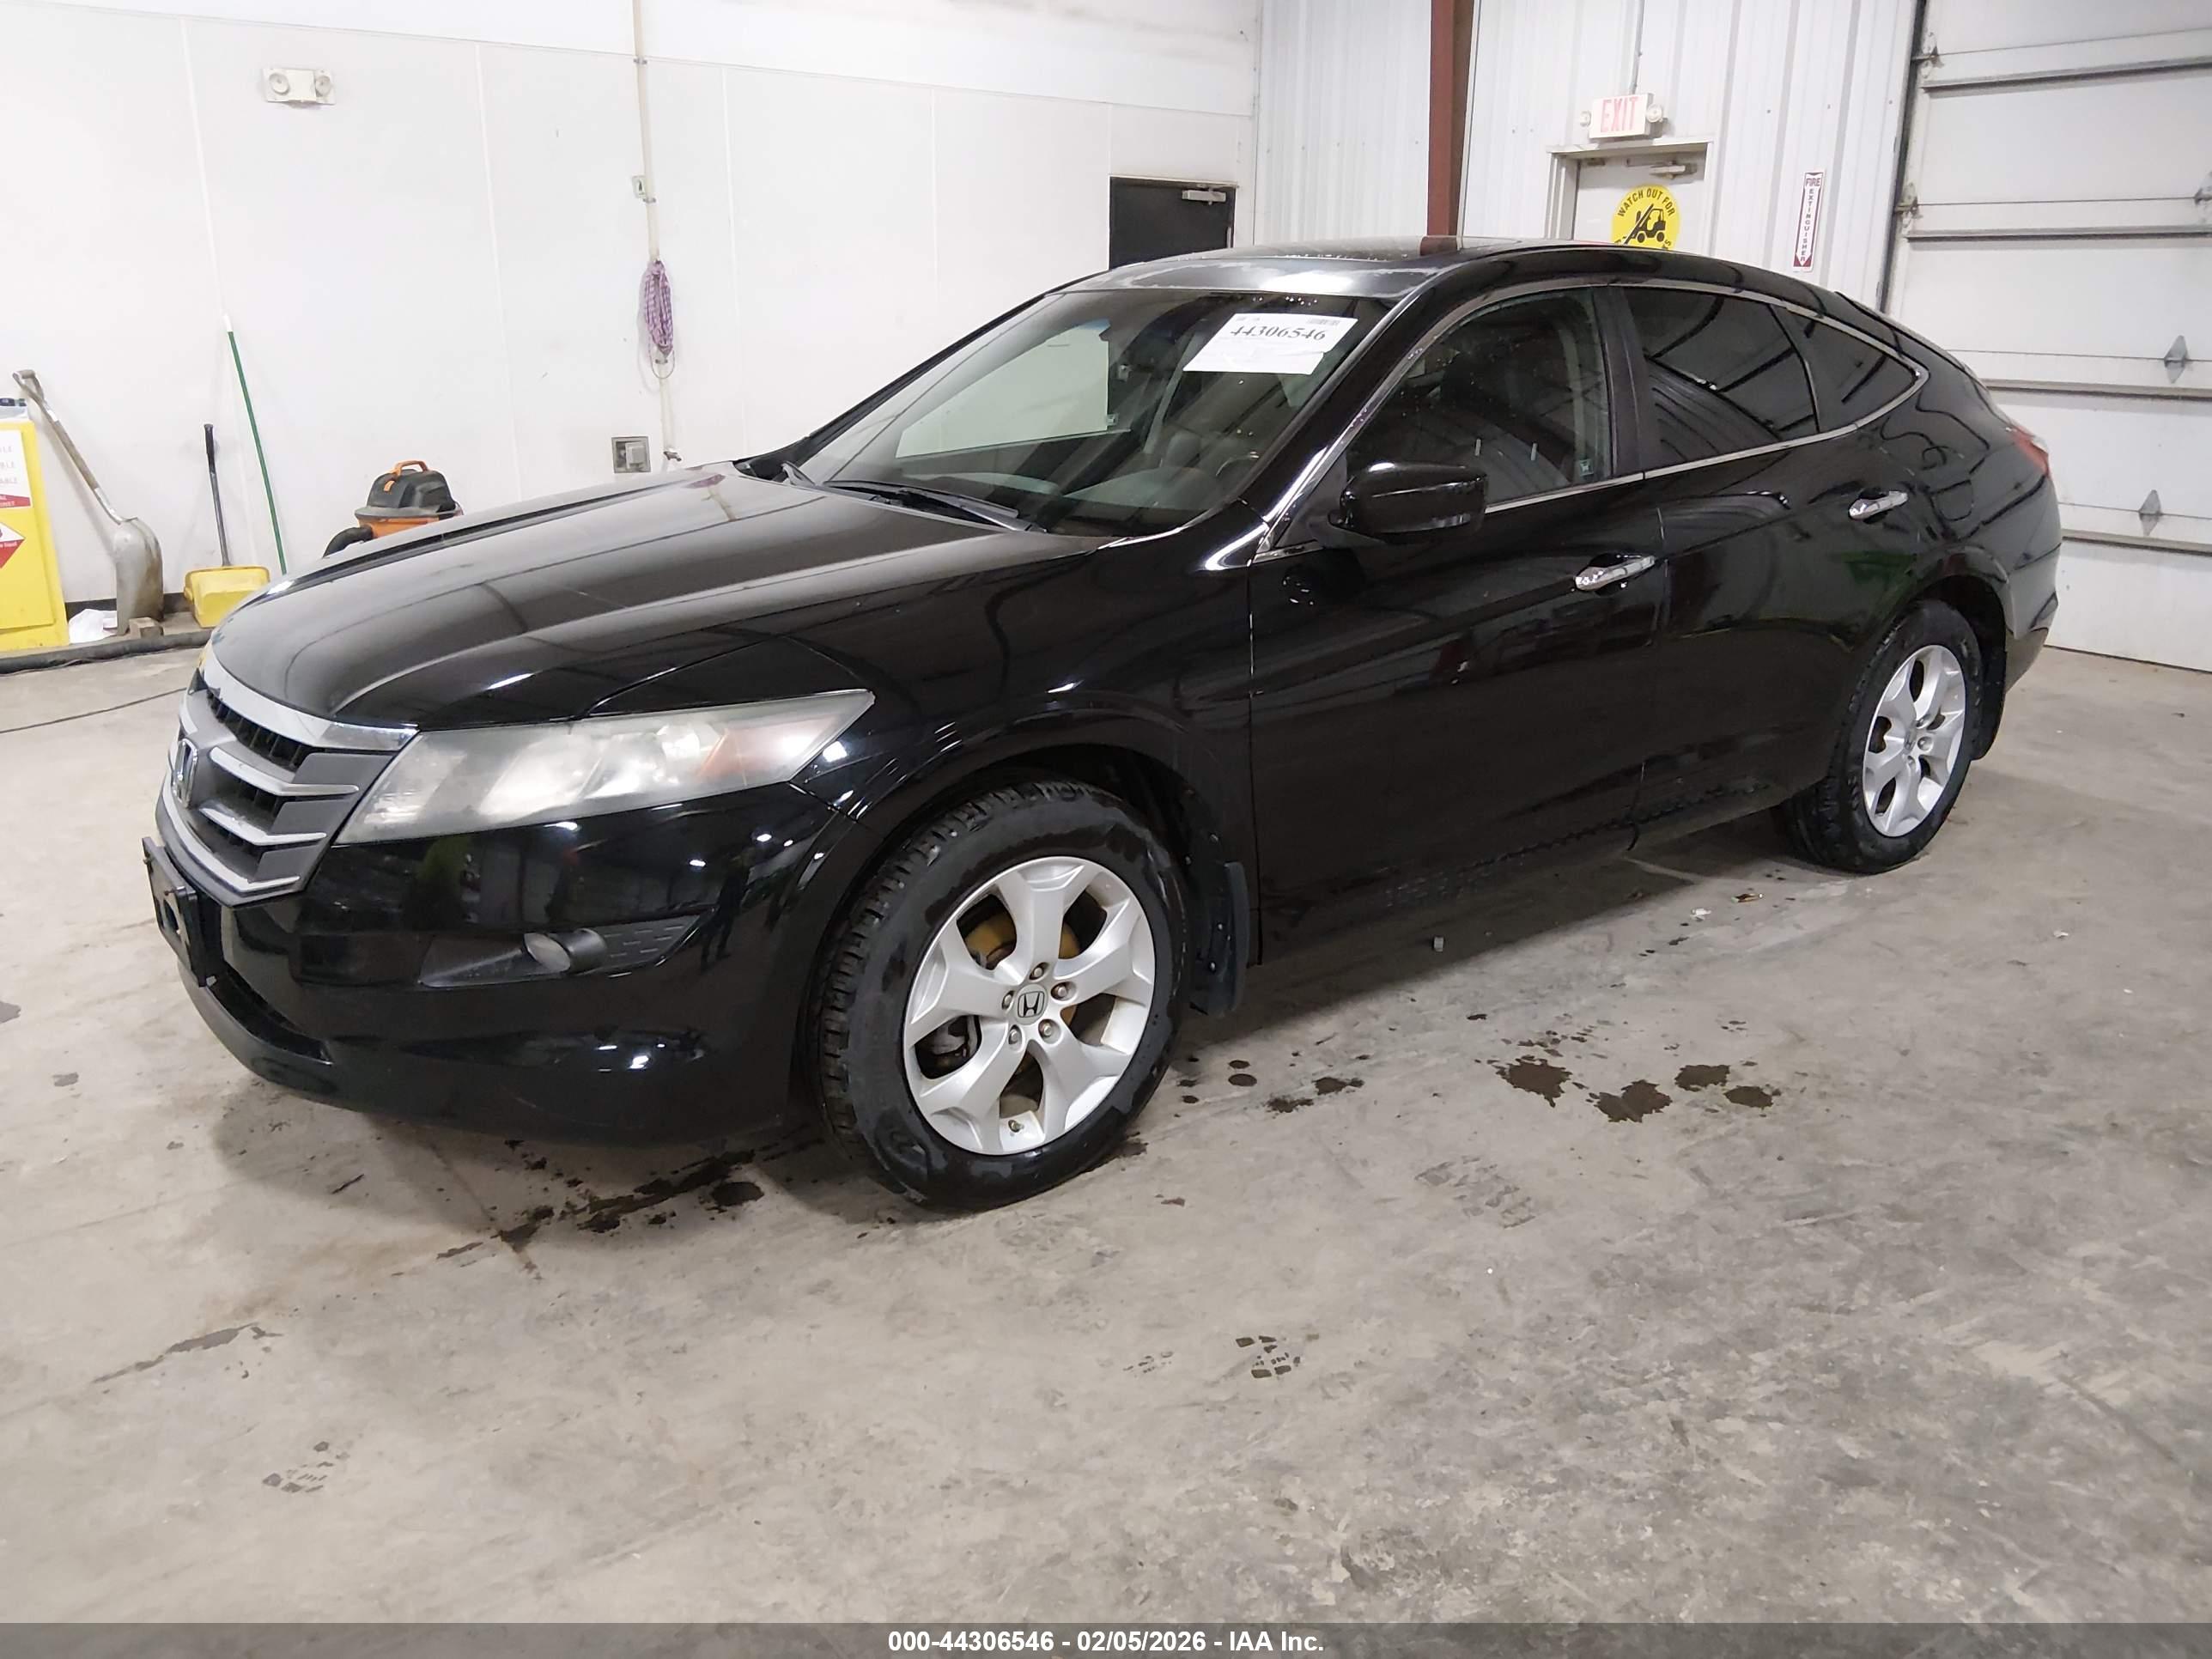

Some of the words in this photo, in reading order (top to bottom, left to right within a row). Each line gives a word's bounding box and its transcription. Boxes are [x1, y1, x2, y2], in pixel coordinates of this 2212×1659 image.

[1600, 96, 1639, 133] EXIT
[1805, 177, 1821, 187] FIRE
[1617, 190, 1644, 217] WATCH
[1646, 188, 1663, 200] OUT
[1662, 197, 1675, 216] FOR
[1800, 188, 1814, 262] EXTINGUISHER
[1230, 325, 1327, 341] 44306546
